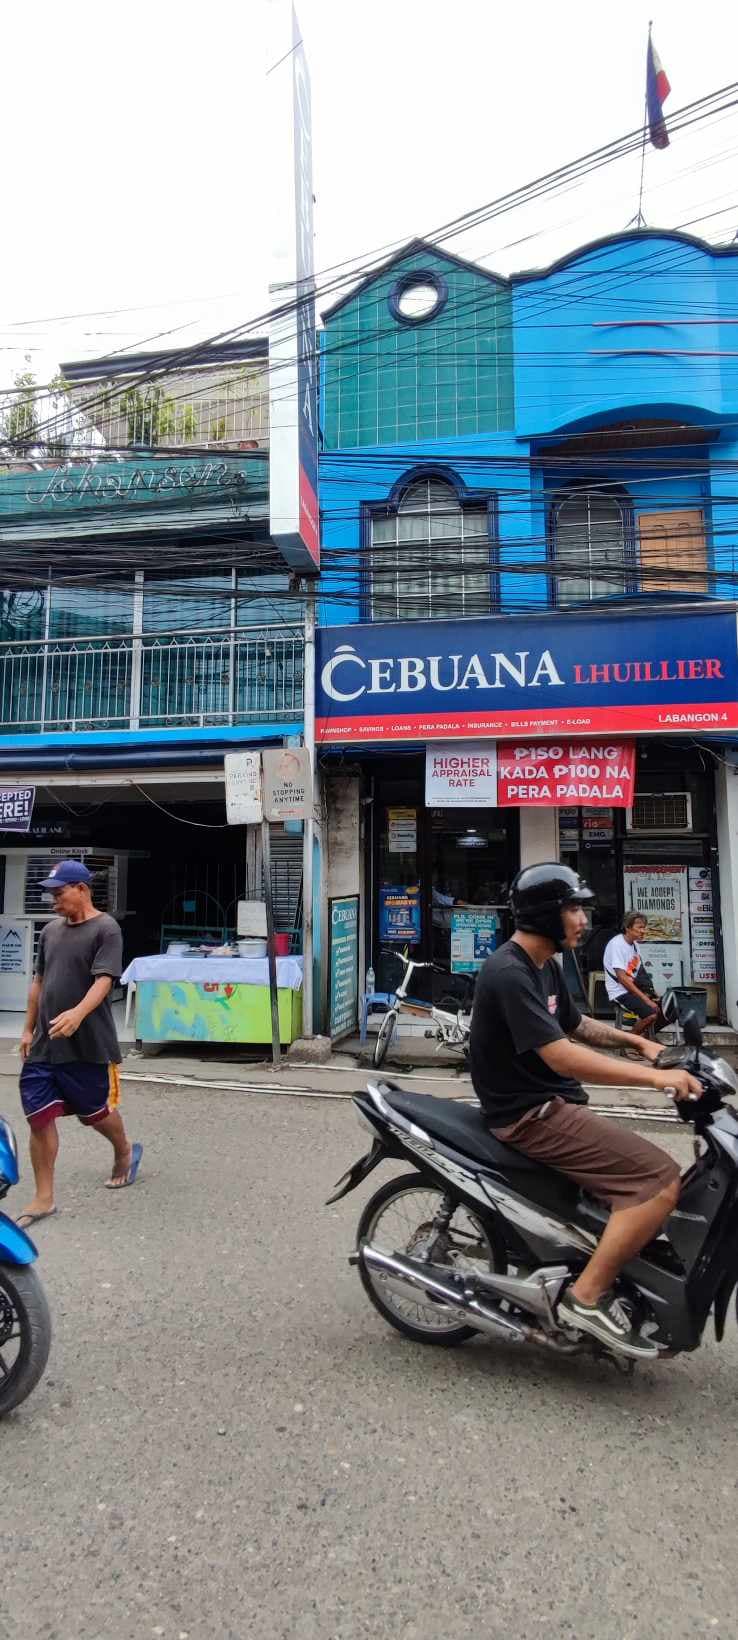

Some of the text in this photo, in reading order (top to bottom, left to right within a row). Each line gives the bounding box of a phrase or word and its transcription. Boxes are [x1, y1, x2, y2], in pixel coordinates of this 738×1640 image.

[321, 645, 725, 702] CEBUANA LHUILLIER
[658, 712, 728, 723] LABANGON 4
[569, 746, 618, 760] LANG
[433, 757, 490, 769] HIGHER
[431, 768, 493, 778] APPRAISAL
[500, 766, 549, 779] KADA
[605, 766, 631, 779] NA
[448, 778, 476, 787] RATE
[272, 788, 305, 796] STOPPING
[507, 783, 624, 799] PERA PADALA
[272, 795, 305, 803] ANYTIME
[637, 886, 674, 897] WE ACCEPT
[637, 898, 676, 910] DIAMONDS
